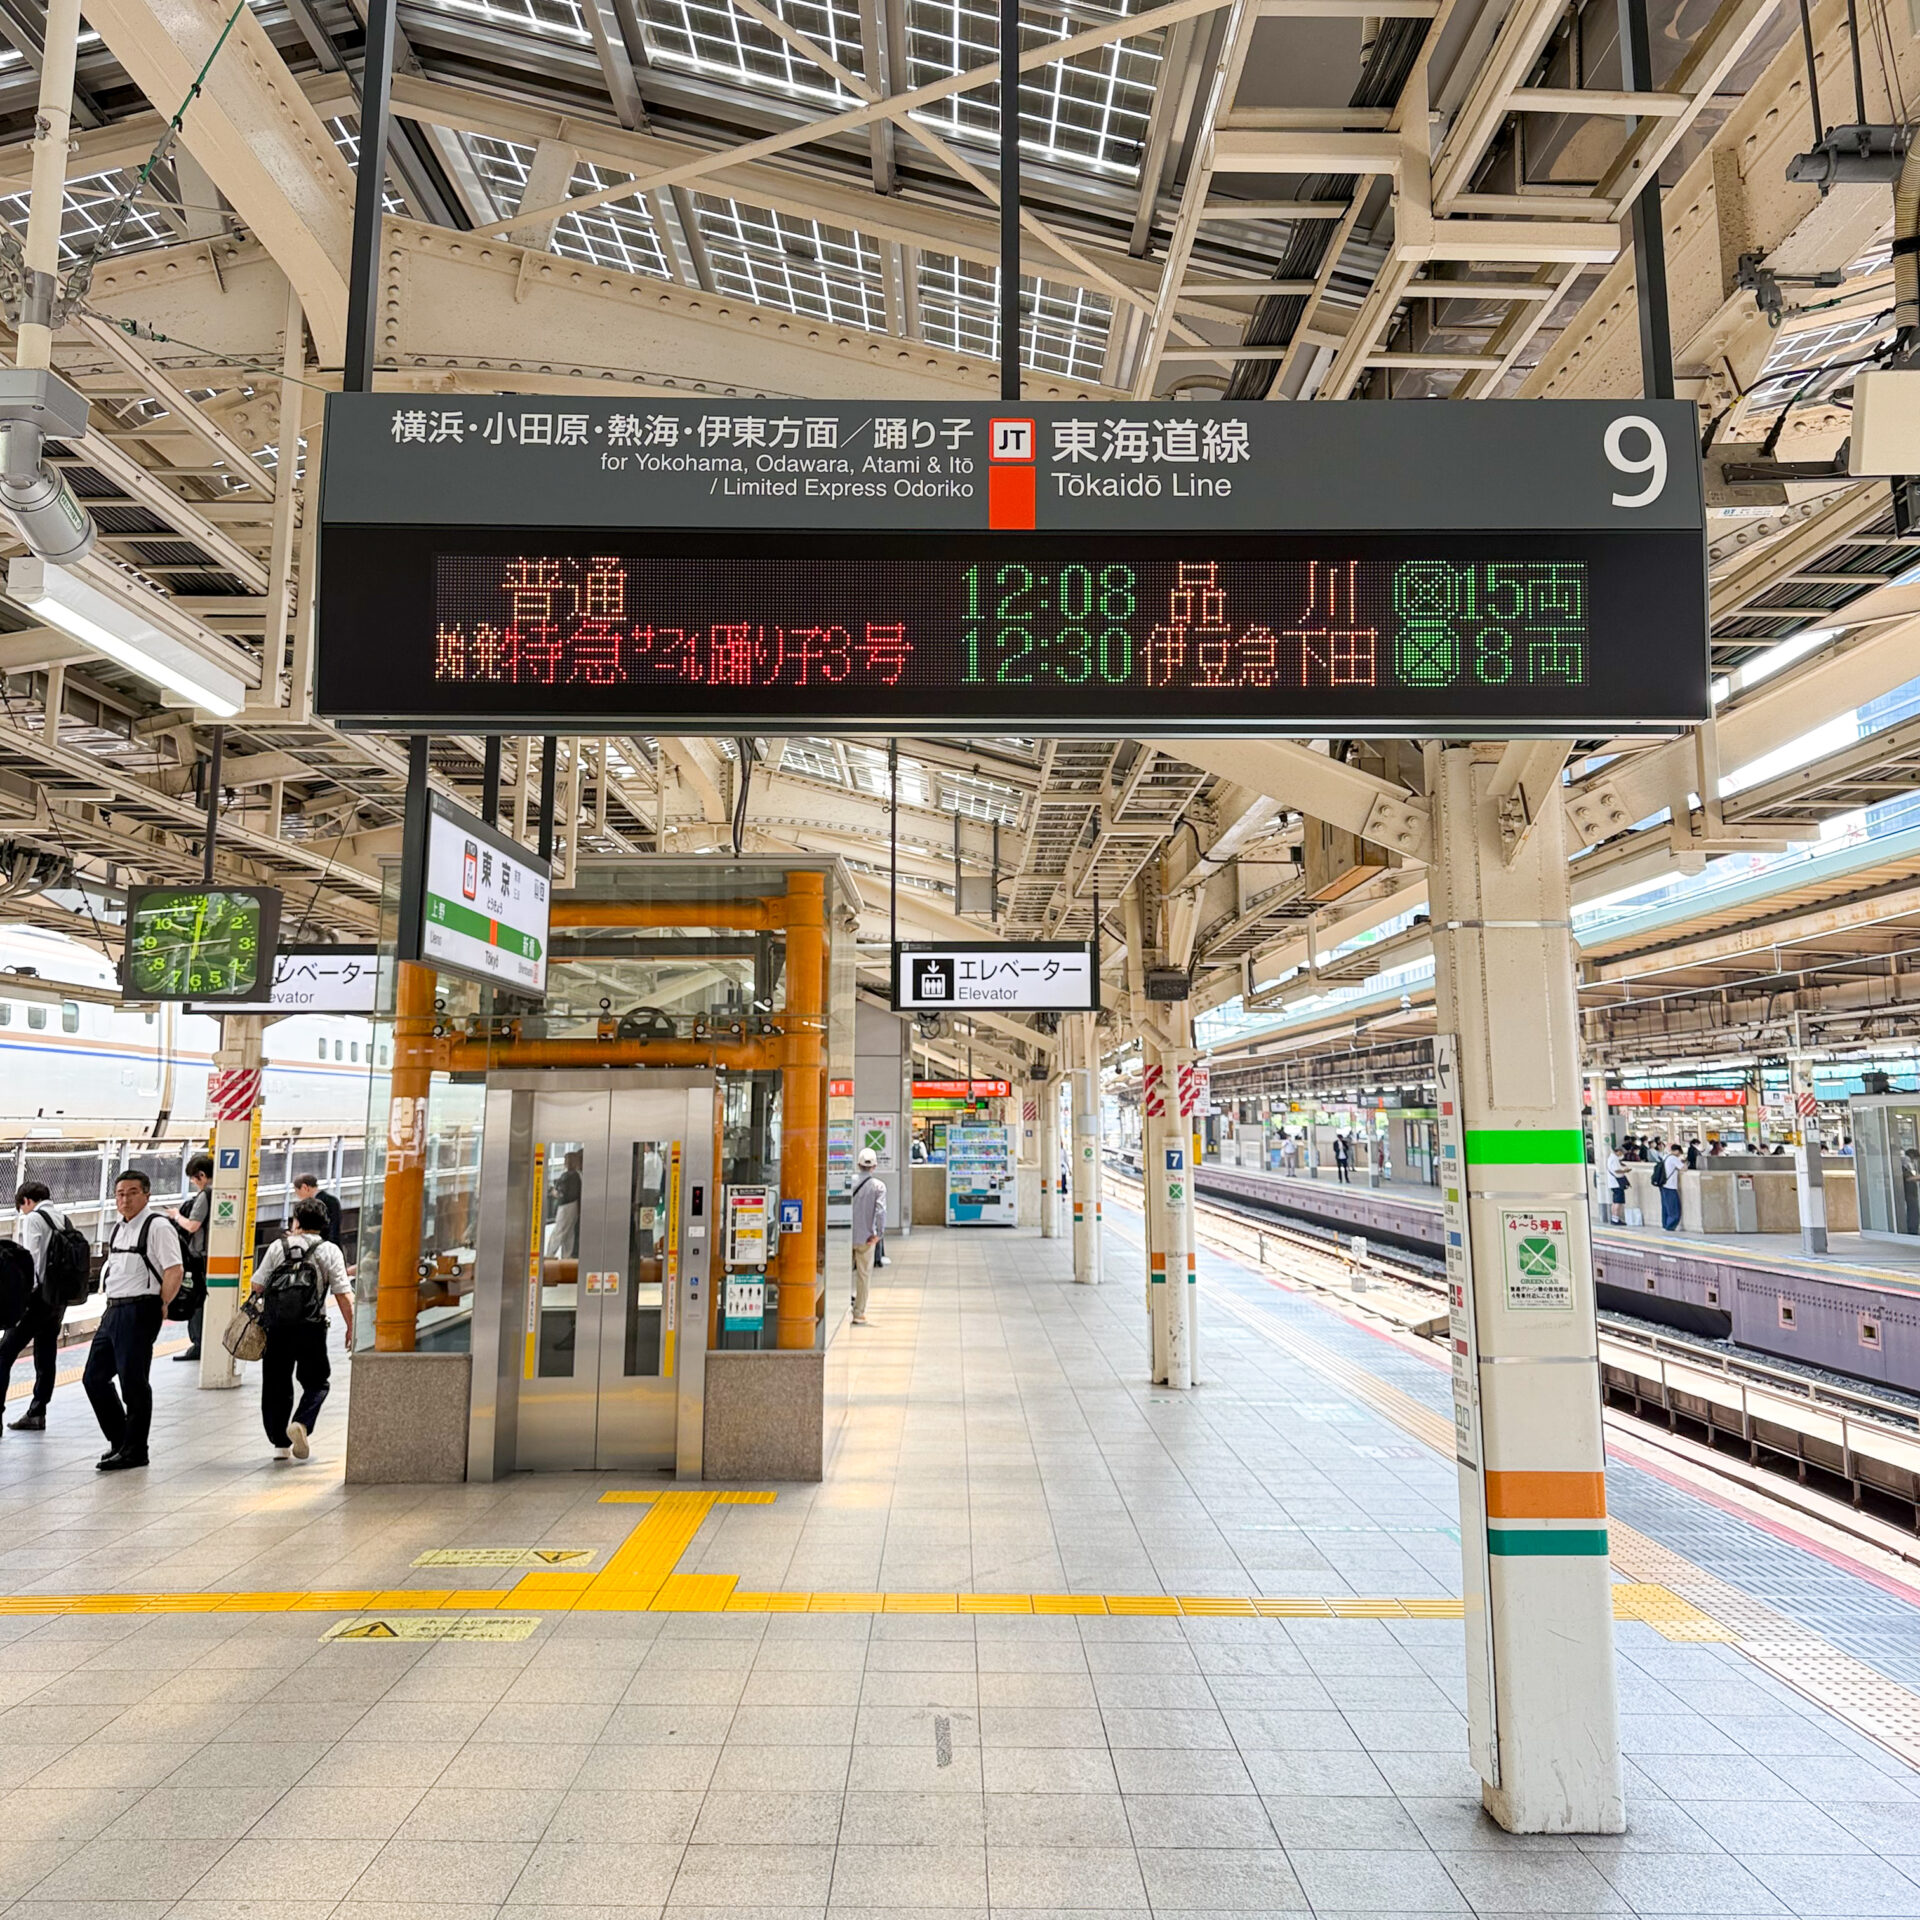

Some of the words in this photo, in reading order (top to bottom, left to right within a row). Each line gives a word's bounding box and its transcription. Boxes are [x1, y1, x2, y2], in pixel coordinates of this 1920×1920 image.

[998, 429, 1026, 450] JT
[1051, 418, 1251, 463] 東海道線
[600, 453, 629, 470] for
[635, 453, 749, 474] Yokohama,
[755, 454, 855, 476] Odawara,
[861, 456, 921, 474] Atami
[926, 457, 942, 474] &
[949, 457, 974, 474] Itō
[1603, 415, 1668, 508] 9
[724, 478, 798, 497] Limited
[804, 479, 888, 500] Express
[893, 479, 974, 498] Odoriko
[1051, 472, 1162, 497] Tōkaidō
[1172, 472, 1232, 497] Line
[502, 556, 628, 621] 普通
[961, 563, 1136, 620] 12:08
[961, 626, 1133, 683] 12:30
[1139, 622, 1379, 688] 伊豆急下田
[481, 850, 512, 898] 東京
[155, 917, 172, 930] 10
[230, 917, 243, 930] 2
[144, 936, 157, 949] 9
[238, 937, 251, 950] 3
[152, 957, 165, 970] 8
[228, 957, 240, 970] 4
[959, 958, 1082, 981] エレベーター
[172, 970, 182, 982] 7
[189, 974, 201, 987] 6
[209, 970, 222, 984] 5
[276, 962, 384, 985] レベーター
[270, 991, 315, 1004] evator
[958, 987, 1018, 1000] Elevator
[996, 1081, 1007, 1096] 9
[1734, 1090, 1743, 1105] 7
[224, 1151, 235, 1167] 7
[1169, 1152, 1180, 1168] 7
